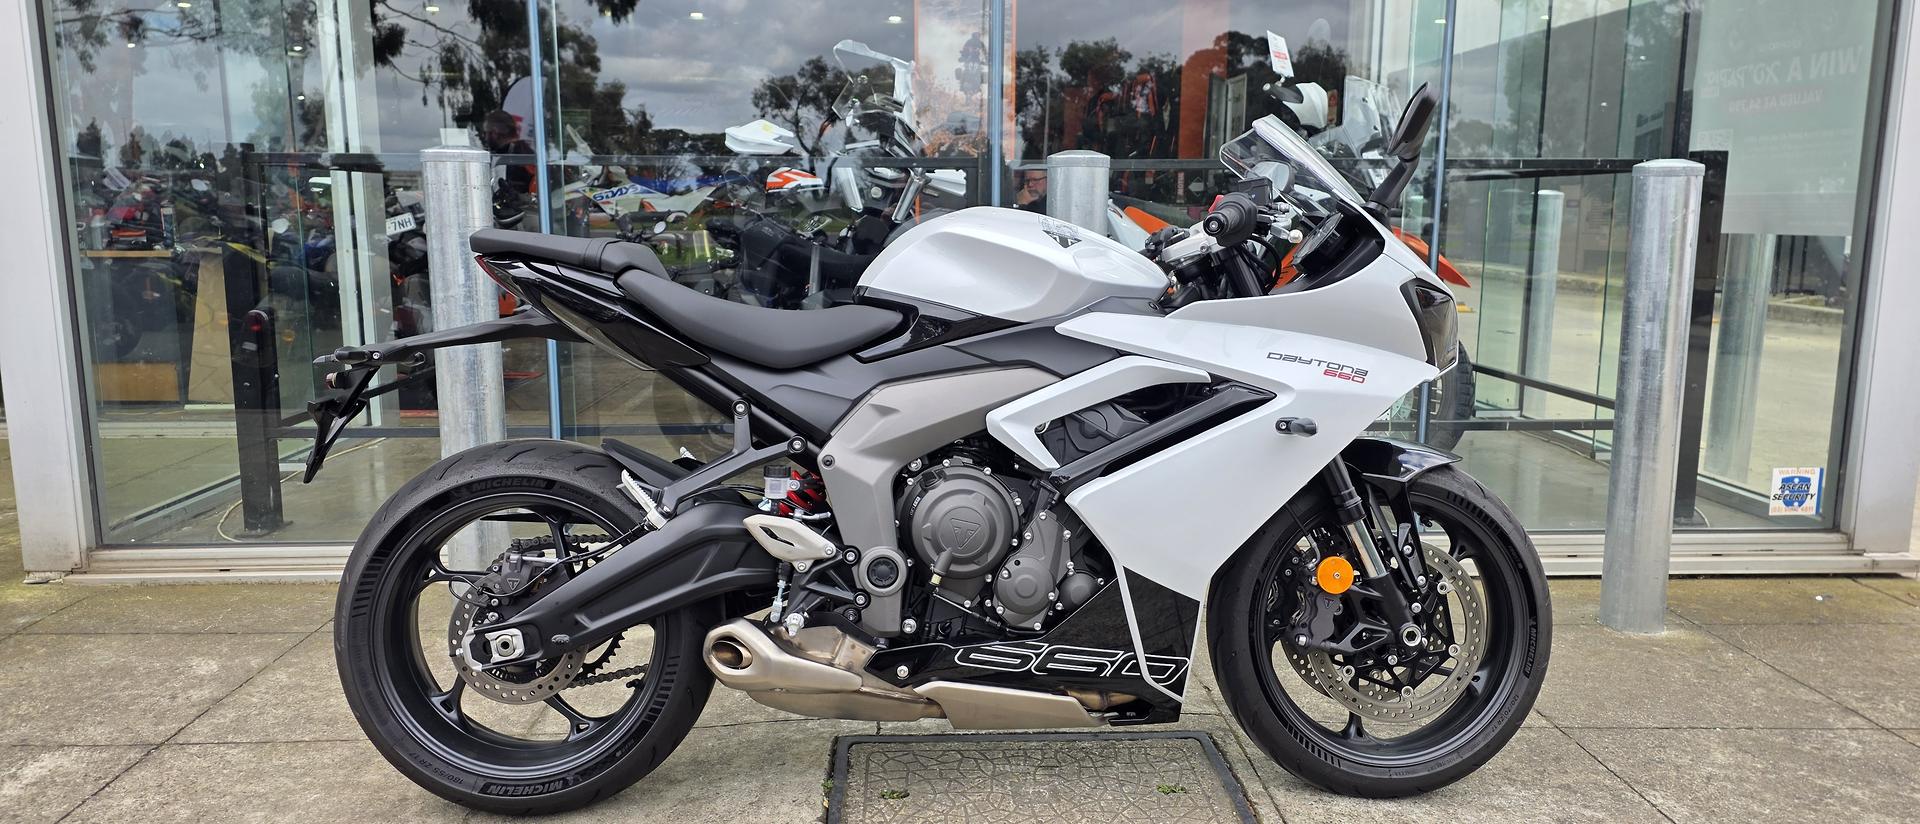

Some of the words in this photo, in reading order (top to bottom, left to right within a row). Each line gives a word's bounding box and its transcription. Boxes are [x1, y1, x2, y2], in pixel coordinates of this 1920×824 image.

[1266, 352, 1368, 377] DAYTONA
[1323, 368, 1366, 384] 660
[472, 477, 546, 493] MICHELIN
[1772, 493, 1816, 501] SECURITY
[1526, 628, 1537, 676] MICHELIN
[954, 641, 1190, 685] 660
[432, 767, 464, 785] 180/55
[487, 781, 565, 796] MICHELIN
